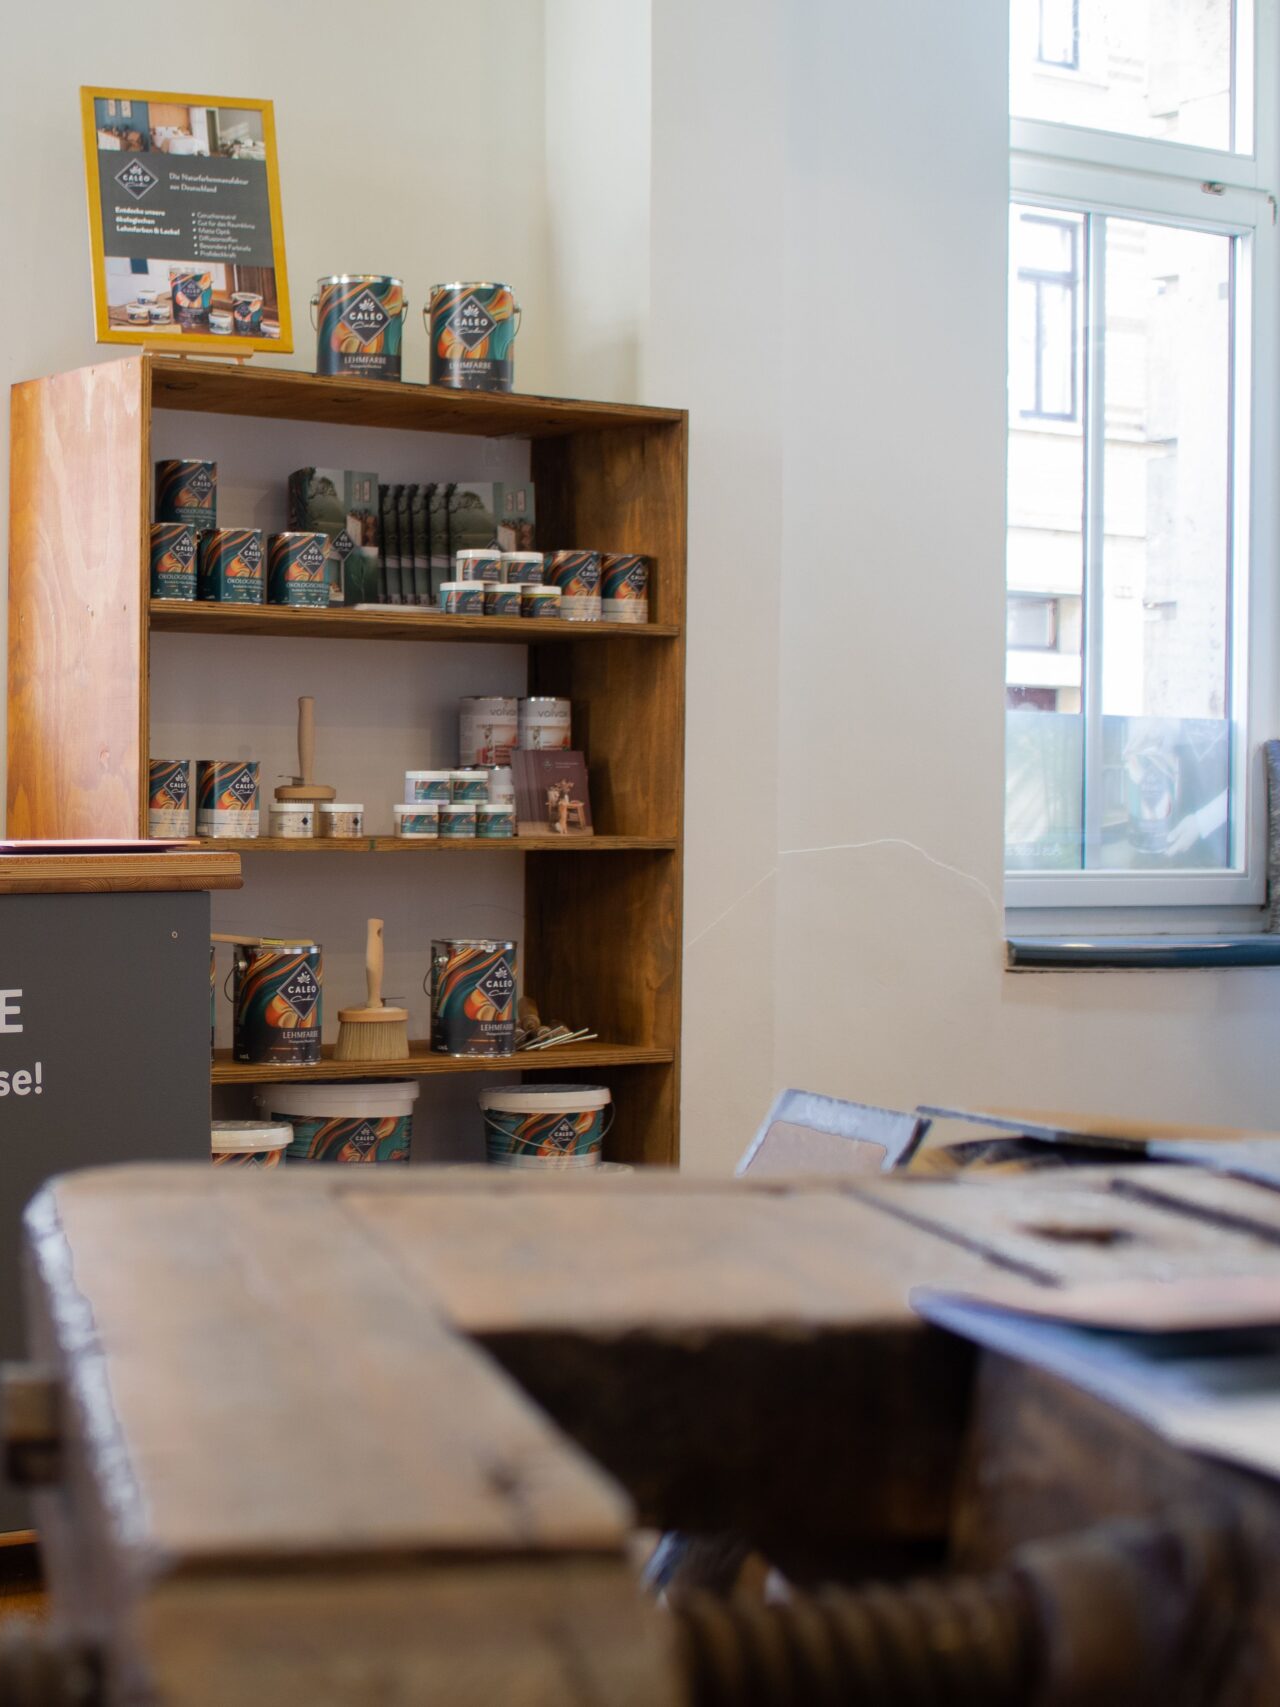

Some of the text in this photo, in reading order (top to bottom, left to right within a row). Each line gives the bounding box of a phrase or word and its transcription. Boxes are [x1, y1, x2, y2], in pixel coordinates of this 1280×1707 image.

[122, 174, 151, 183] CALEO
[349, 311, 383, 321] CALEO
[453, 318, 488, 327] CALEO
[344, 356, 387, 365] LEHMFARBE
[486, 980, 513, 988] CALEO
[288, 986, 317, 994] CALEO
